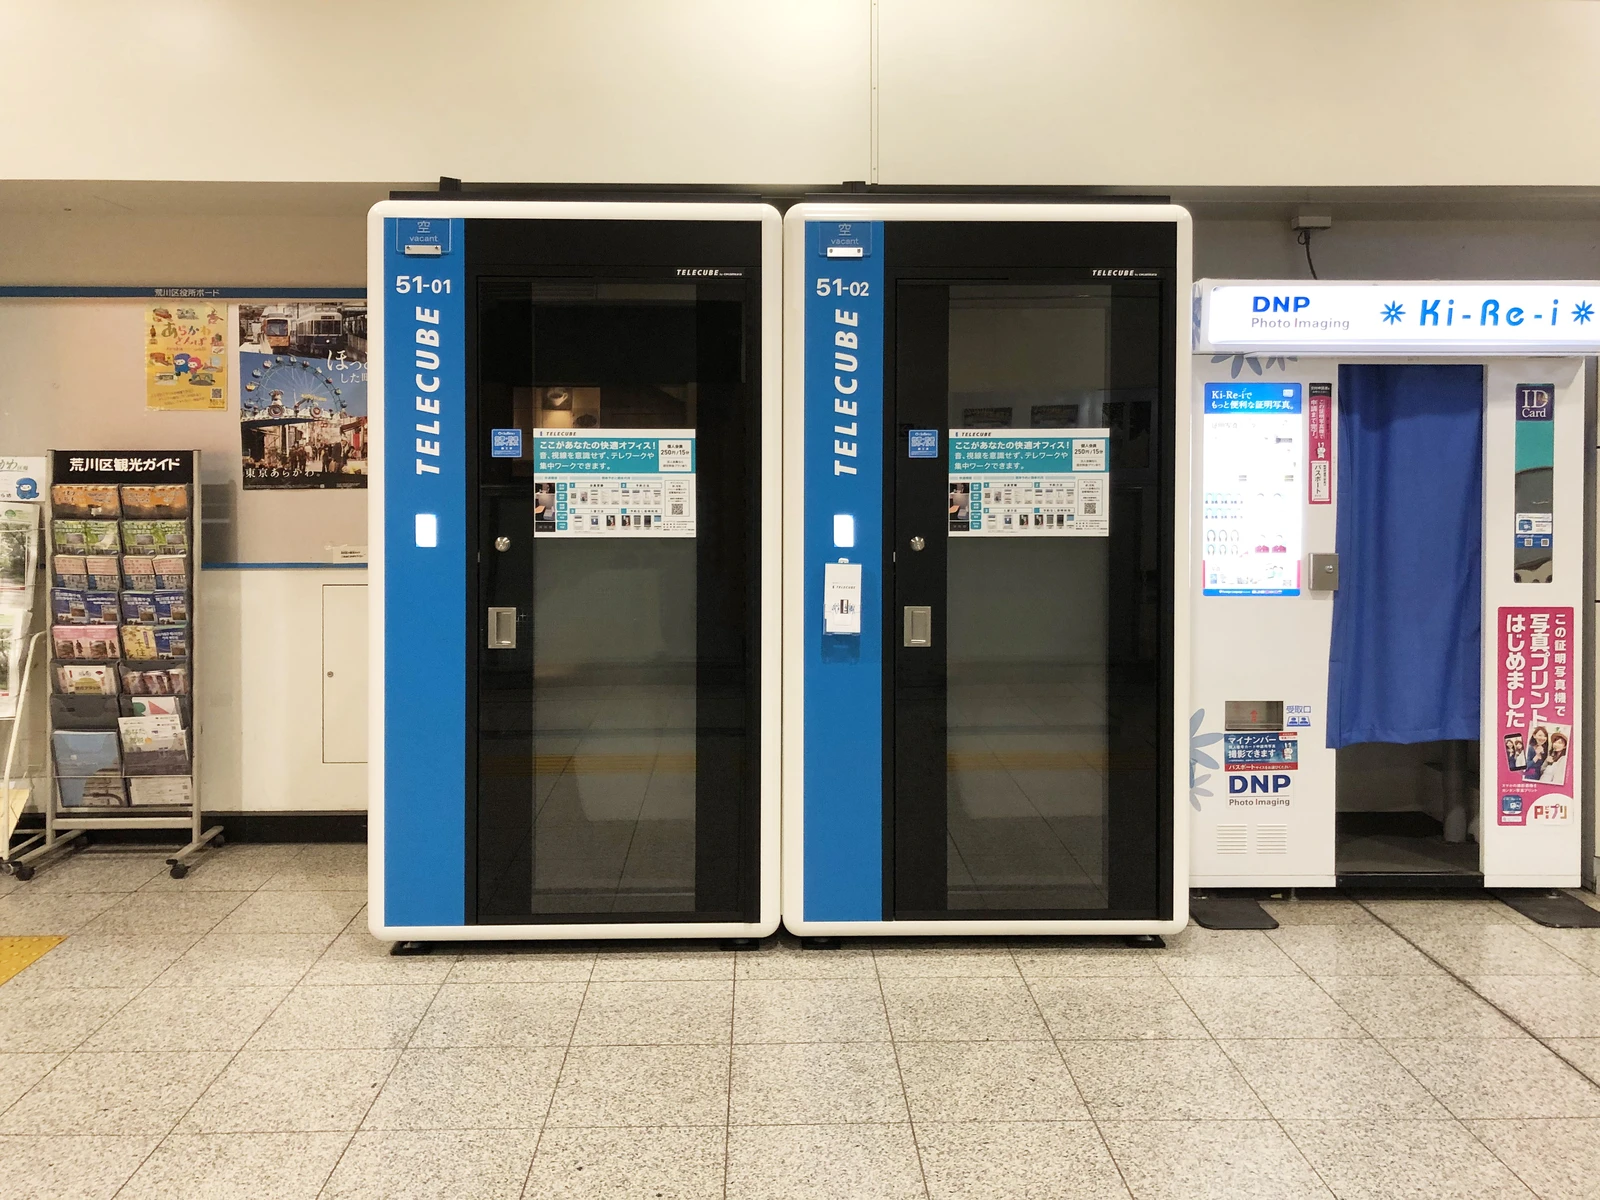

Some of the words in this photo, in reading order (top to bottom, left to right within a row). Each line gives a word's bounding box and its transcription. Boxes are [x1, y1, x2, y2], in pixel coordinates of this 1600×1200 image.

[417, 220, 430, 233] 空
[838, 223, 852, 236] 空
[409, 235, 439, 243] vacant
[154, 288, 220, 297] 荒川区役所ボード
[395, 275, 451, 294] 51-01
[816, 278, 869, 297] 51-02
[1252, 296, 1310, 313] DNP
[1419, 299, 1559, 326] Ki-Re-i
[161, 322, 211, 338] あらかわ
[1251, 317, 1291, 329] Photo
[1294, 317, 1350, 331] Imaging
[415, 306, 440, 475] TELECUBE
[834, 309, 859, 476] TELECUBE
[1521, 389, 1549, 408] ID
[1521, 408, 1547, 418] Card
[69, 457, 181, 472] 荒川区観光ガイド
[1506, 614, 1526, 728] はじめました
[1530, 613, 1550, 727] 写真プリント
[1554, 614, 1567, 717] この証明写真機で
[1286, 705, 1312, 714] 受取口
[1228, 735, 1277, 745] マイナンバー
[1228, 774, 1291, 794] DNP
[1228, 798, 1254, 806] Photo
[1255, 798, 1291, 807] Imaging
